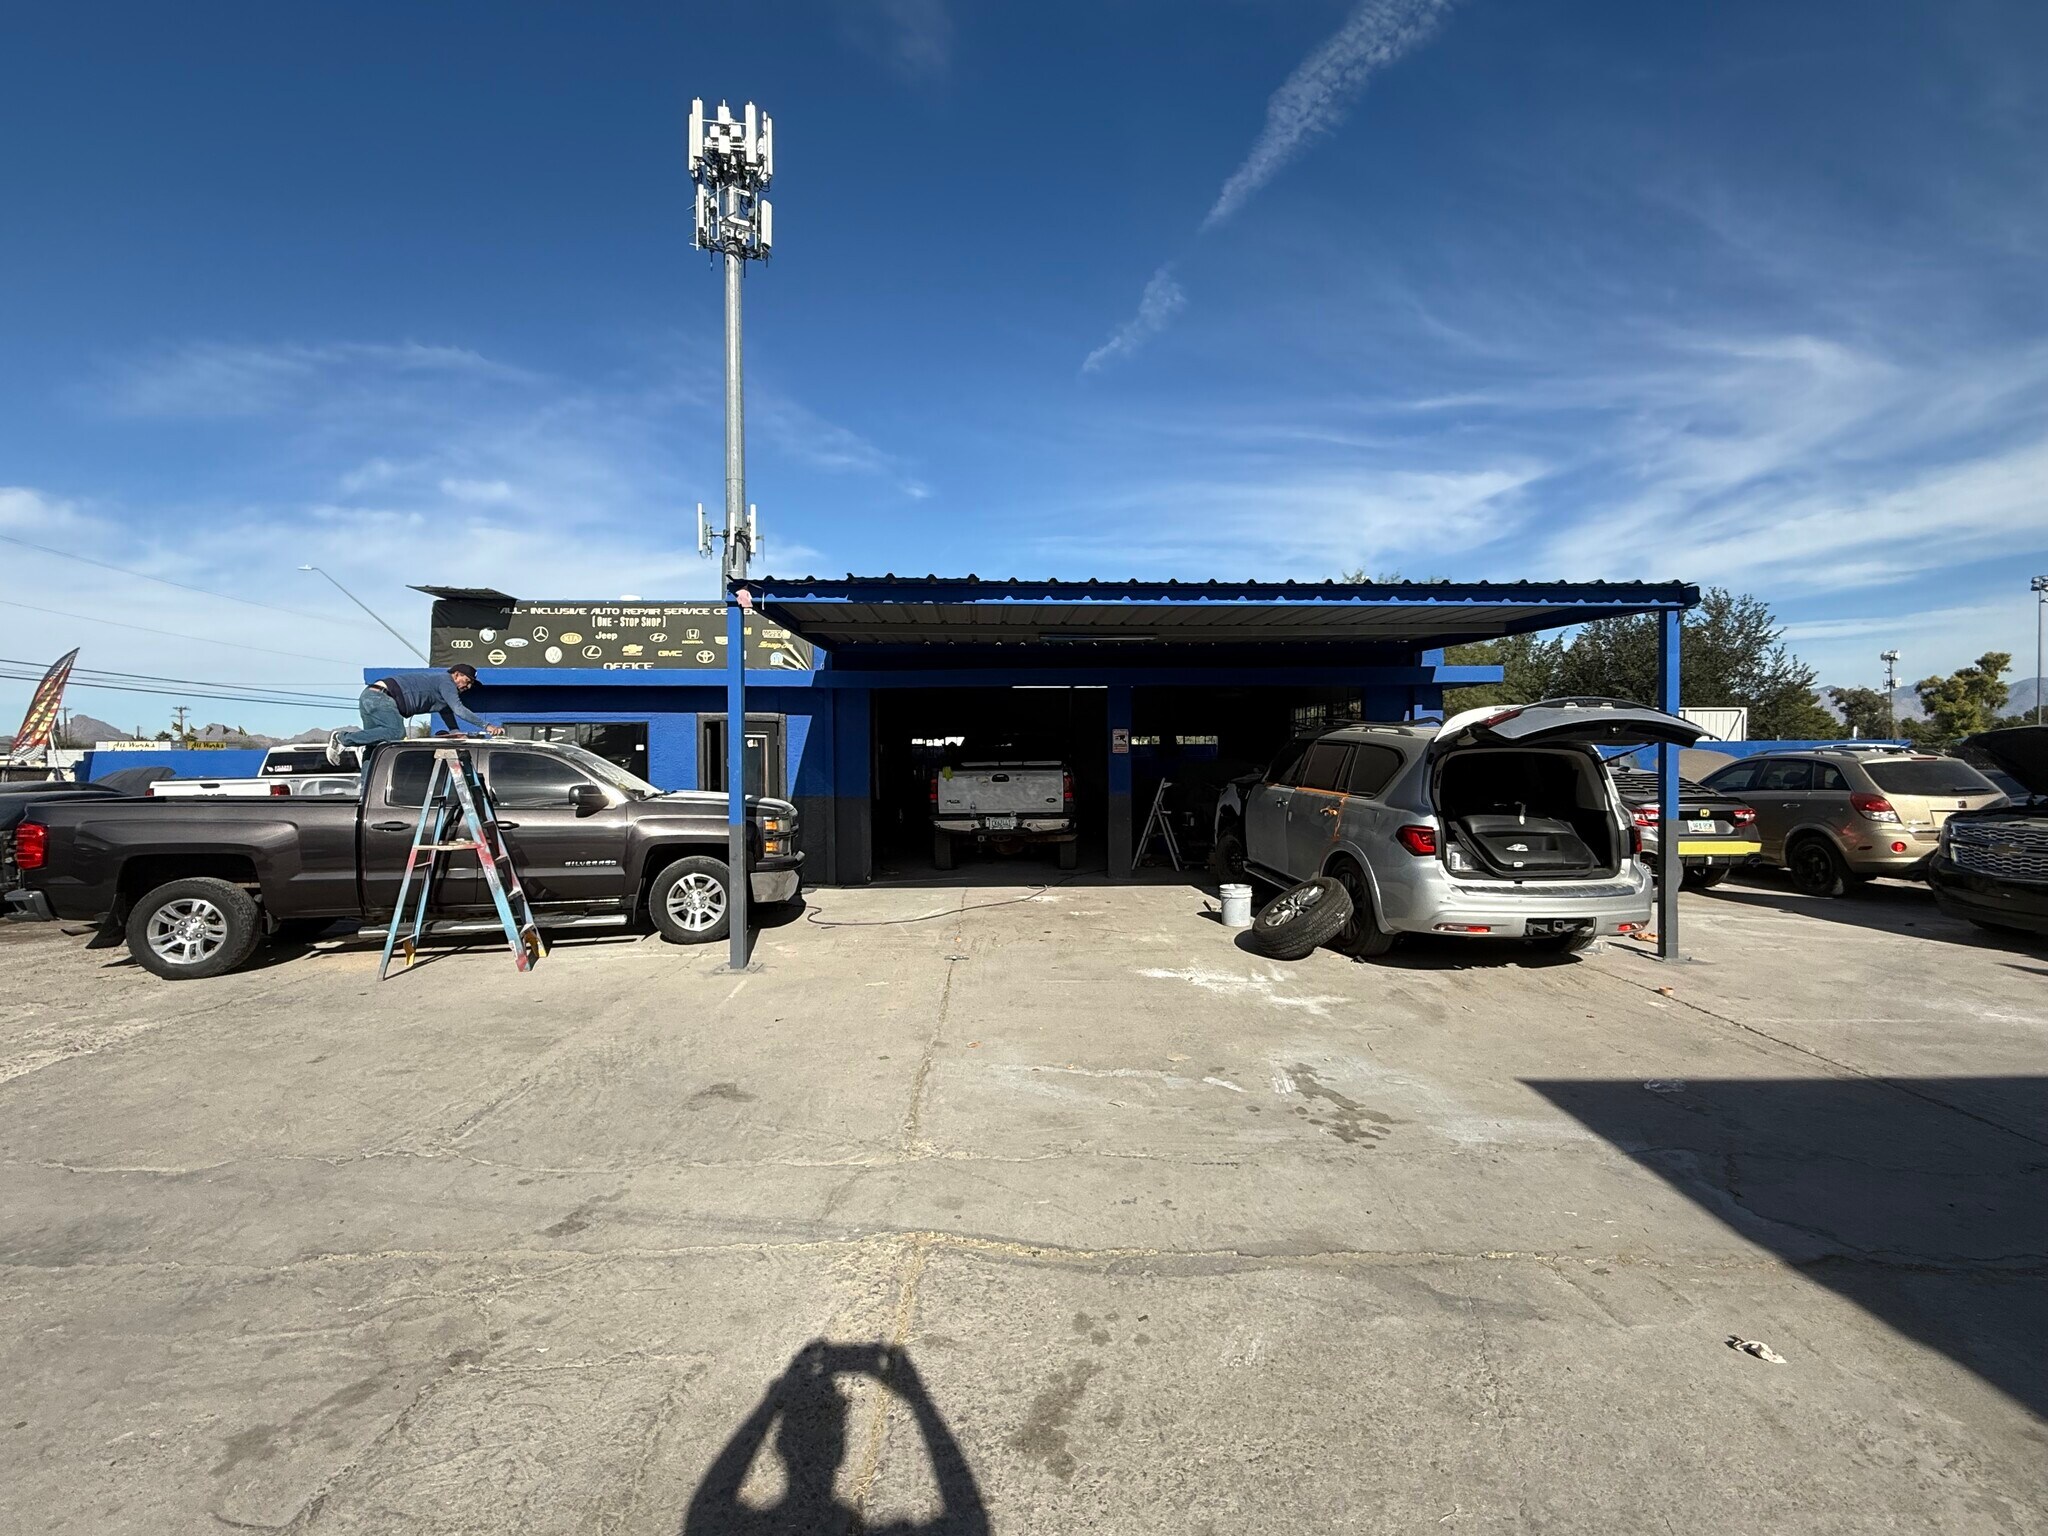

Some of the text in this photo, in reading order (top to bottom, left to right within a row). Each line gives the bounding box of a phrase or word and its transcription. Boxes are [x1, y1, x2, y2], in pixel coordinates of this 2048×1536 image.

[530, 607, 588, 615] INCLUSIVE
[590, 607, 620, 615] AUTO
[622, 607, 661, 615] REPAIR
[663, 607, 710, 615] SERVICE
[595, 631, 618, 641] Jeep
[603, 662, 655, 670] OFFICE
